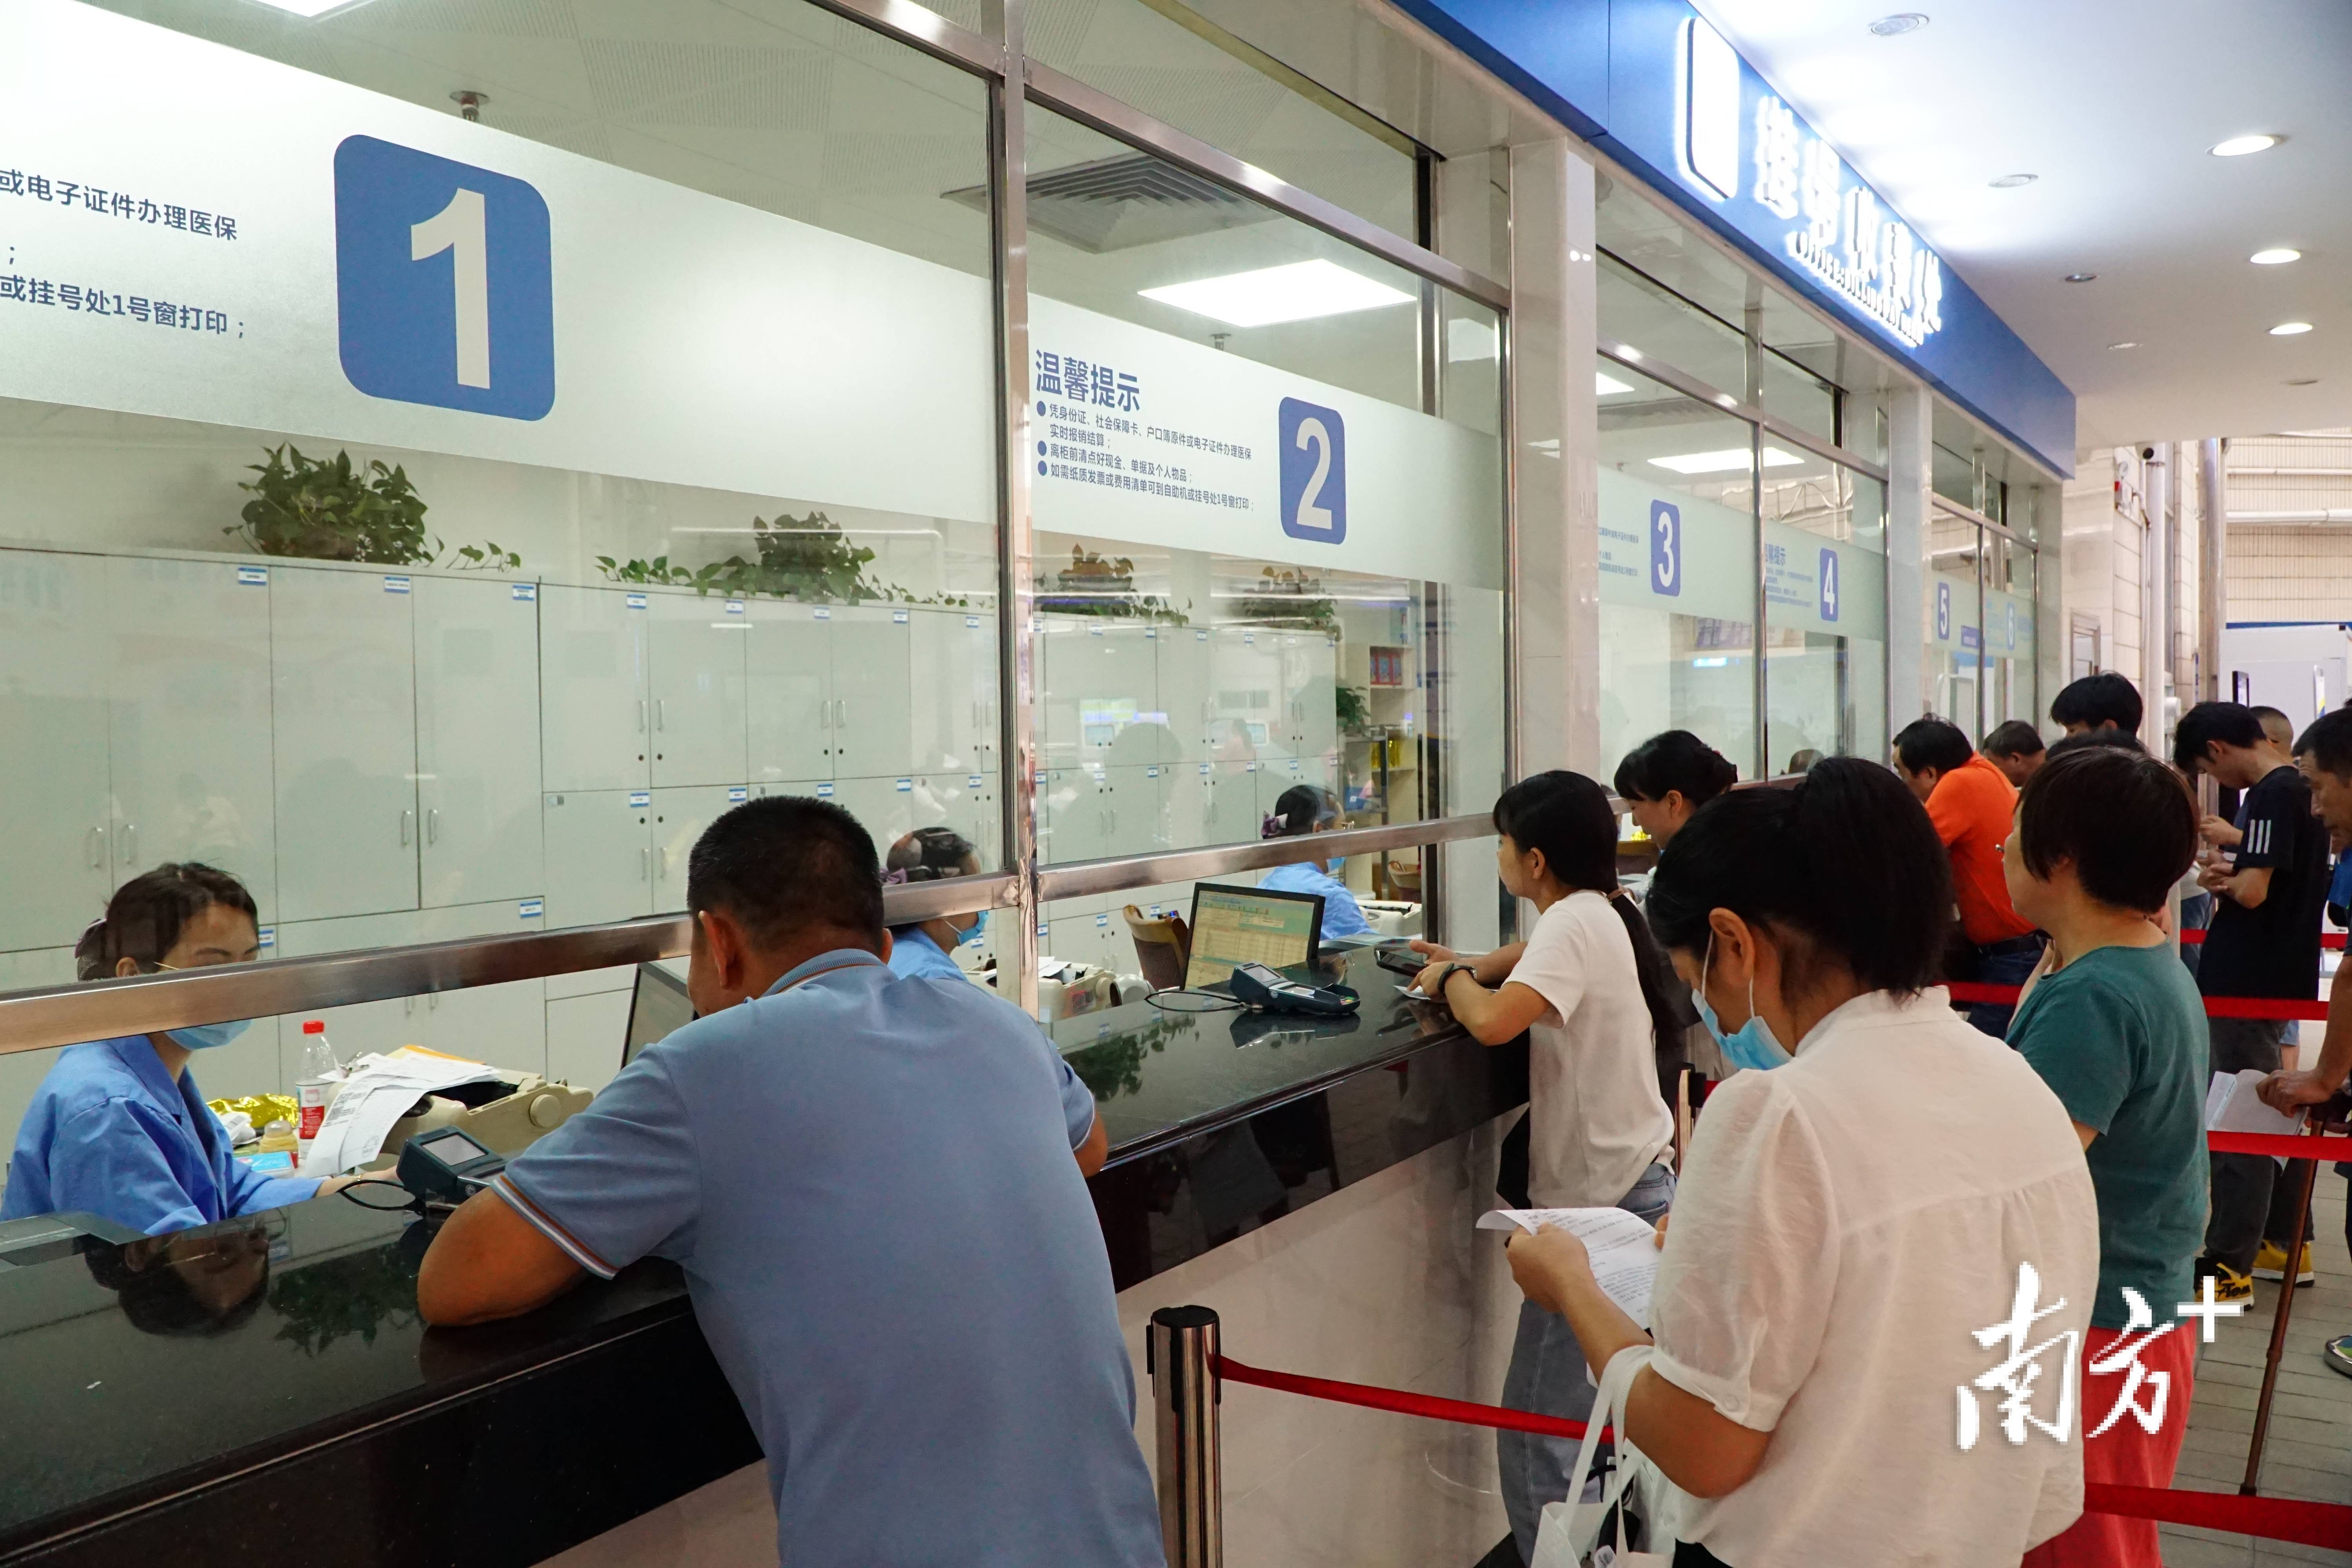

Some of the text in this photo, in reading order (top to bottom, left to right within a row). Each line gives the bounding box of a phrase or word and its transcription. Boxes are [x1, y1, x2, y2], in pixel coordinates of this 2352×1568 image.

[0, 168, 237, 241] 或电子证件办理医保
[412, 187, 490, 389] 1
[1036, 349, 1140, 412] 温馨提示
[1049, 403, 1251, 460] 凭身份证、社会保障卡、户口簿原件或电子证件办理医保
[1296, 417, 1332, 530] 2
[1658, 511, 1674, 588] 3
[1824, 557, 1835, 615] 4
[1940, 589, 1948, 635] 5
